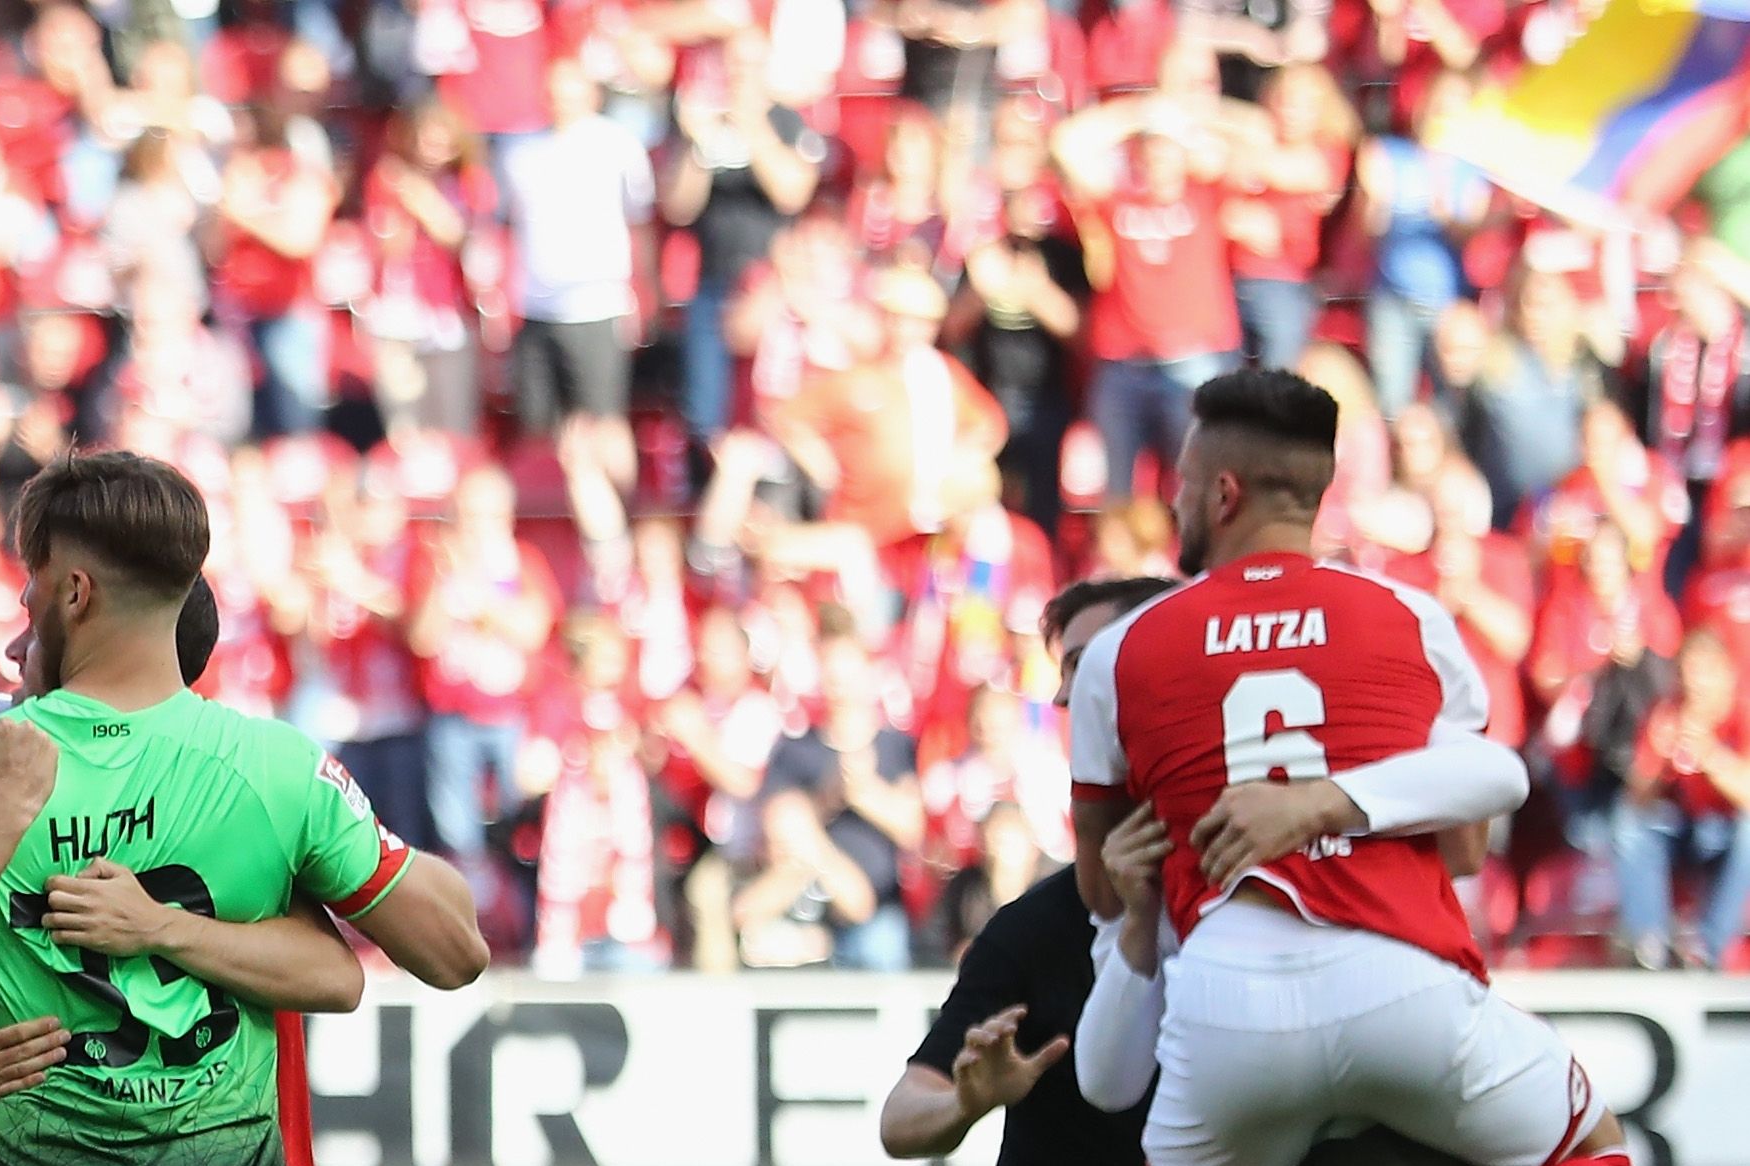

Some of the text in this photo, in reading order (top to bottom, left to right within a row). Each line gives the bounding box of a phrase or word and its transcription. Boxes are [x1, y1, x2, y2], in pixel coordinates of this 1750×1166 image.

[1204, 607, 1327, 656] LATZA
[92, 723, 131, 739] 1905
[1221, 668, 1329, 785] 6
[48, 795, 156, 863] HUTH
